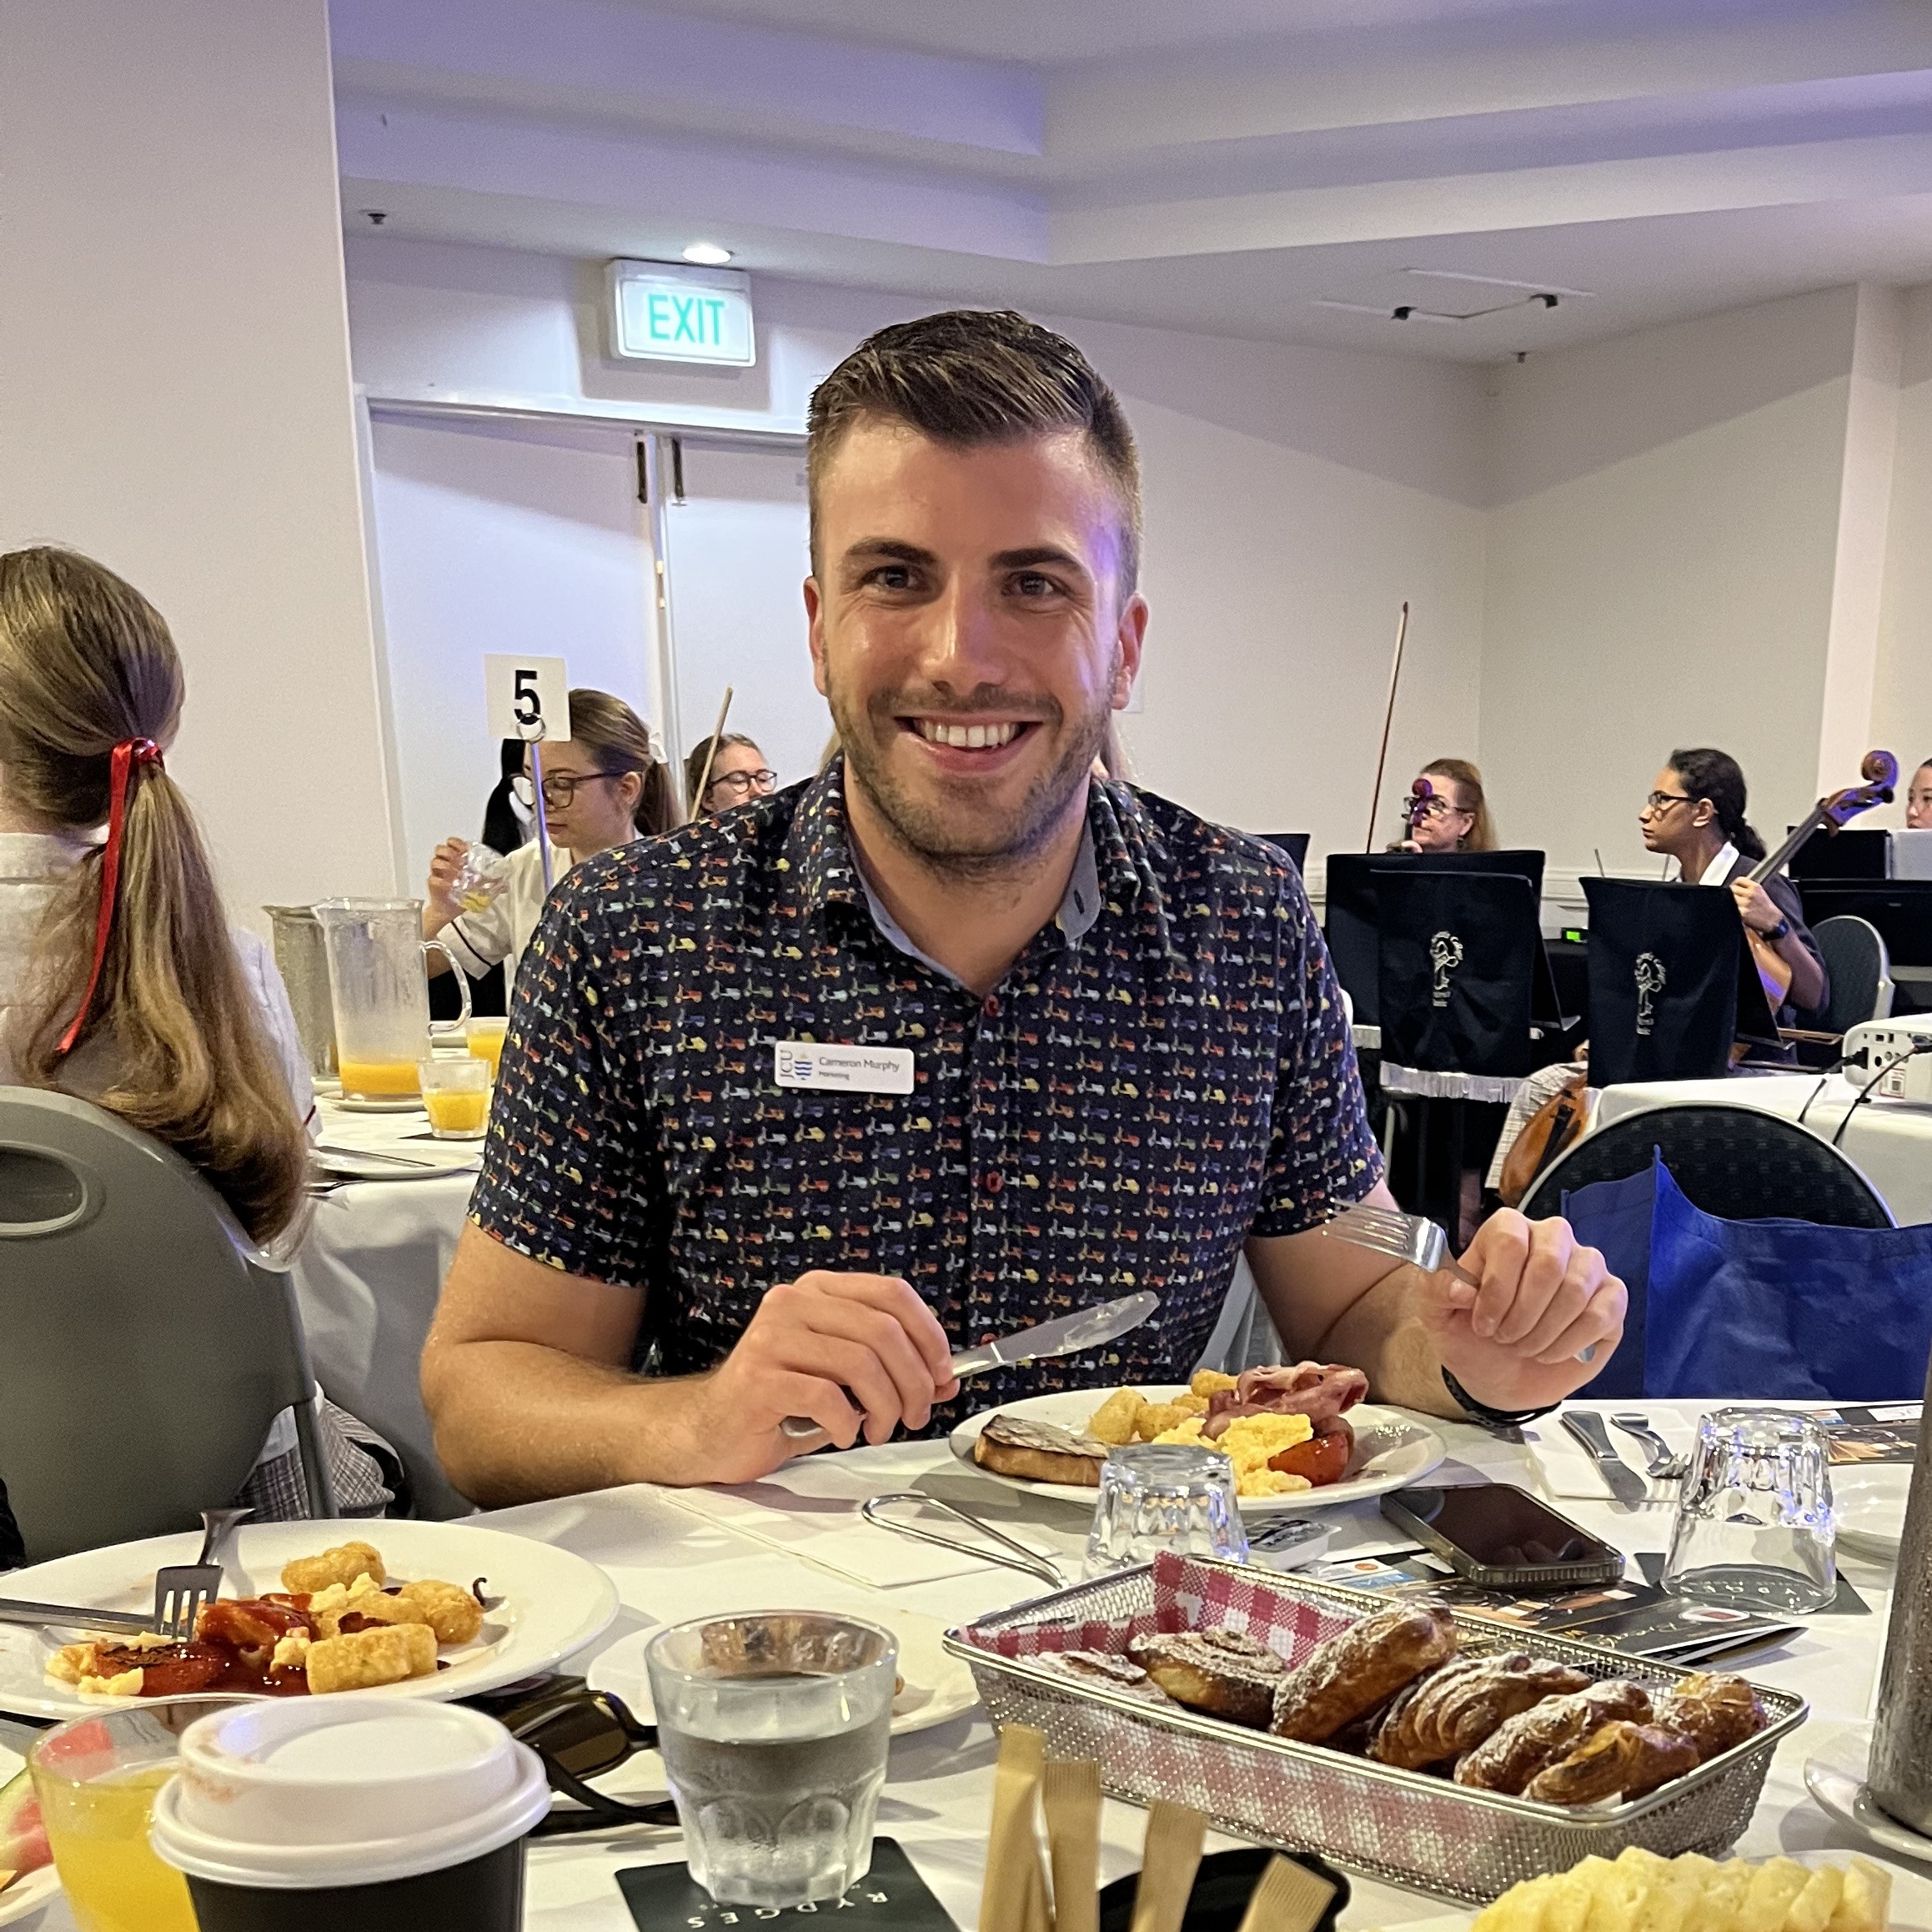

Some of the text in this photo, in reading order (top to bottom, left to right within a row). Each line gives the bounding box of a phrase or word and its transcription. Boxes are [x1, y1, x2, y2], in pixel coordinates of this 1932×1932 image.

[648, 293, 725, 346] EXIT
[514, 669, 540, 725] 5
[819, 1056, 900, 1073] Cameron Murphy
[687, 1892, 889, 1929] RYDGES
